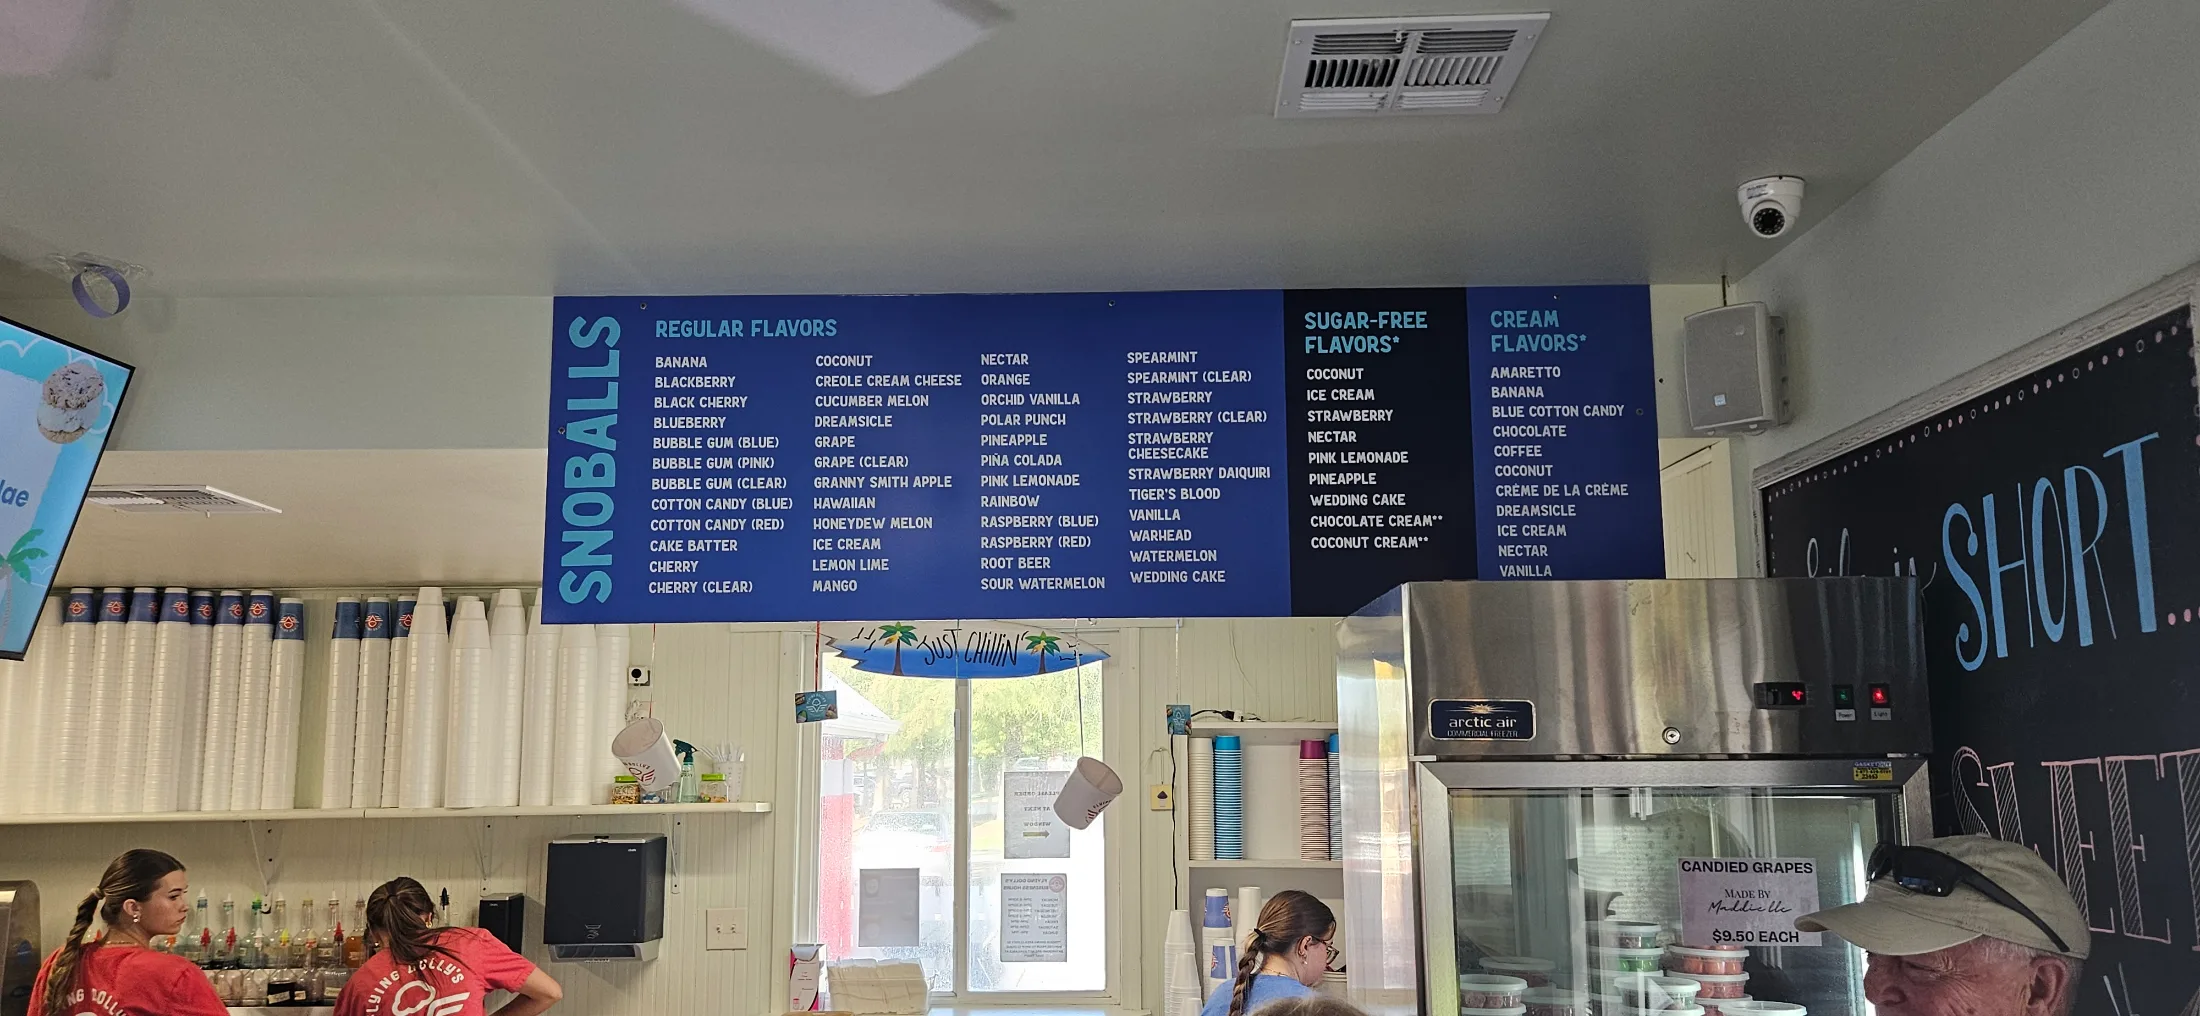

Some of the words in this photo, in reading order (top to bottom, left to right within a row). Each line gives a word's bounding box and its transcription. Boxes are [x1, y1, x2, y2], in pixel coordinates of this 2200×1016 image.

[1304, 311, 1428, 330] SUGAR-FREE
[1490, 310, 1559, 328] CREAM
[655, 319, 744, 338] REGULAR
[751, 318, 837, 337] FLAVORS
[655, 356, 708, 369] BANANA
[815, 355, 874, 367] COCONUT
[980, 353, 1029, 366] NECTAR
[1127, 351, 1198, 364] SPEARMINT
[980, 373, 1031, 386] ORANGE
[1127, 371, 1199, 384] SPEARMINT
[1202, 370, 1252, 383] (CLEAR)
[1306, 367, 1364, 381] COCONUT
[1490, 366, 1561, 379] AMARETTO
[654, 375, 736, 389] BLACKBERRY
[815, 375, 863, 388] CREOLE
[866, 374, 911, 387] CREAM
[914, 374, 962, 387] CHEESE
[981, 393, 1025, 406] ORCHID
[1028, 393, 1081, 406] VANILLA
[1127, 391, 1213, 405] STRAWBERRY
[1306, 389, 1327, 401] ICE
[1330, 388, 1375, 401] CREAM
[1491, 386, 1545, 399] BANANA
[654, 396, 695, 409] BLACK
[699, 395, 748, 408] CHERRY
[815, 395, 883, 408] CUCUMBER
[886, 394, 929, 407] MELON
[1127, 411, 1214, 425] STRAWBERRY
[1217, 410, 1267, 423] (CLEAR)
[1307, 409, 1394, 423] STRAWBERRY
[1492, 405, 1525, 418] BLUE
[1528, 405, 1579, 418] COTTON
[1583, 404, 1625, 417] CANDY
[653, 416, 727, 429] BLUEBERRY
[814, 415, 893, 428] DREAMSICLE
[980, 413, 1021, 426] POLAR
[1025, 413, 1066, 426] PUNCH
[1127, 431, 1214, 445] STRAWBERRY
[1307, 430, 1357, 443] NECTAR
[1492, 425, 1567, 438] CHOCOLATE
[652, 436, 703, 449] BUBBLE
[706, 436, 734, 449] GUM
[738, 436, 779, 449] (BLUE)
[814, 435, 856, 448] GRAPE
[980, 433, 1048, 447] PINEAPPLE
[1128, 446, 1209, 460] CHEESECAKE
[1308, 451, 1337, 464] PINK
[1340, 451, 1409, 464] LEMONADE
[1493, 444, 1543, 457] COFFEE
[558, 314, 622, 604] SNOBALLS
[652, 457, 702, 470] BUBBLE
[706, 457, 734, 470] GUM
[737, 456, 775, 469] (PINK)
[814, 455, 855, 468] GRAPE
[859, 455, 909, 468] (CLEAR)
[1013, 454, 1063, 467] COLADA
[1128, 466, 1214, 480] STRAWBERRY
[1218, 466, 1271, 480] DAIQUIRI
[1494, 464, 1554, 477] COCONUT
[651, 477, 702, 490] BUBBLE
[705, 477, 733, 490] GUM
[737, 477, 787, 490] (CLEAR)
[813, 476, 866, 489] GRANNY
[869, 475, 909, 489] SMITH
[912, 475, 953, 488] APPLE
[980, 474, 1009, 488] PINK
[1012, 473, 1081, 487] LEMONADE
[1308, 472, 1377, 485] PINEAPPLE
[1128, 487, 1177, 501] TIGER'S
[1180, 487, 1221, 500] BLOOD
[1543, 484, 1560, 497] DE
[1563, 484, 1581, 497] LA
[651, 498, 702, 511] COTTON
[705, 497, 748, 510] CANDY
[751, 497, 793, 510] (BLUE)
[813, 496, 876, 510] HAWAIIAN
[980, 494, 1040, 508] RAINBOW
[1309, 493, 1368, 507] WEDDING
[1372, 493, 1406, 506] CAKE
[1128, 508, 1181, 522] VANILLA
[1496, 504, 1577, 517] DREAMSICLE
[650, 518, 701, 532] COTTON
[704, 518, 747, 531] CANDY
[751, 518, 785, 531] (RED)
[813, 517, 886, 530] HONEYDEW
[889, 516, 933, 530] MELON
[980, 515, 1054, 528] RASPBERRY
[1058, 514, 1099, 528] (BLUE)
[1310, 515, 1385, 528] CHOCOLATE
[1129, 529, 1192, 542] WARHEAD
[1497, 524, 1518, 537] ICE
[1522, 524, 1567, 537] CREAM
[649, 539, 684, 552] CAKE
[687, 539, 738, 552] BATTER
[812, 538, 833, 551] ICE
[837, 537, 882, 551] CREAM
[980, 535, 1054, 549] RASPBERRY
[1058, 535, 1091, 548] (RED)
[1310, 536, 1370, 549] COCONUT
[1129, 549, 1217, 563] WATERMELON
[1498, 544, 1548, 557] NECTAR
[649, 560, 699, 573] CHERRY
[812, 558, 856, 572] LEMON
[859, 558, 890, 571] LIME
[980, 557, 1014, 570] ROOT
[1018, 556, 1051, 569] BEER
[1129, 570, 1188, 584] WEDDING
[1192, 570, 1226, 583] CAKE
[1499, 564, 1552, 577] VANILLA
[648, 581, 699, 594] CHERRY
[702, 580, 753, 594] (CLEAR)
[812, 579, 858, 592] MANGO
[980, 577, 1014, 590] SOUR
[1018, 576, 1106, 590] WATERMELON
[917, 628, 963, 666] JUST
[1449, 716, 1493, 728] arctic
[1496, 716, 1517, 728] air
[1447, 730, 1488, 738] COMMERCIAL
[1490, 730, 1518, 738] FREEZER
[1681, 860, 1749, 873] CANDIED
[1752, 862, 1813, 874] GRAPES
[1724, 888, 1756, 899] MADE
[1708, 900, 1766, 914] Maddie
[1767, 901, 1793, 913] llc
[1712, 929, 1755, 944] $9.50
[1758, 931, 1800, 943] EACH
